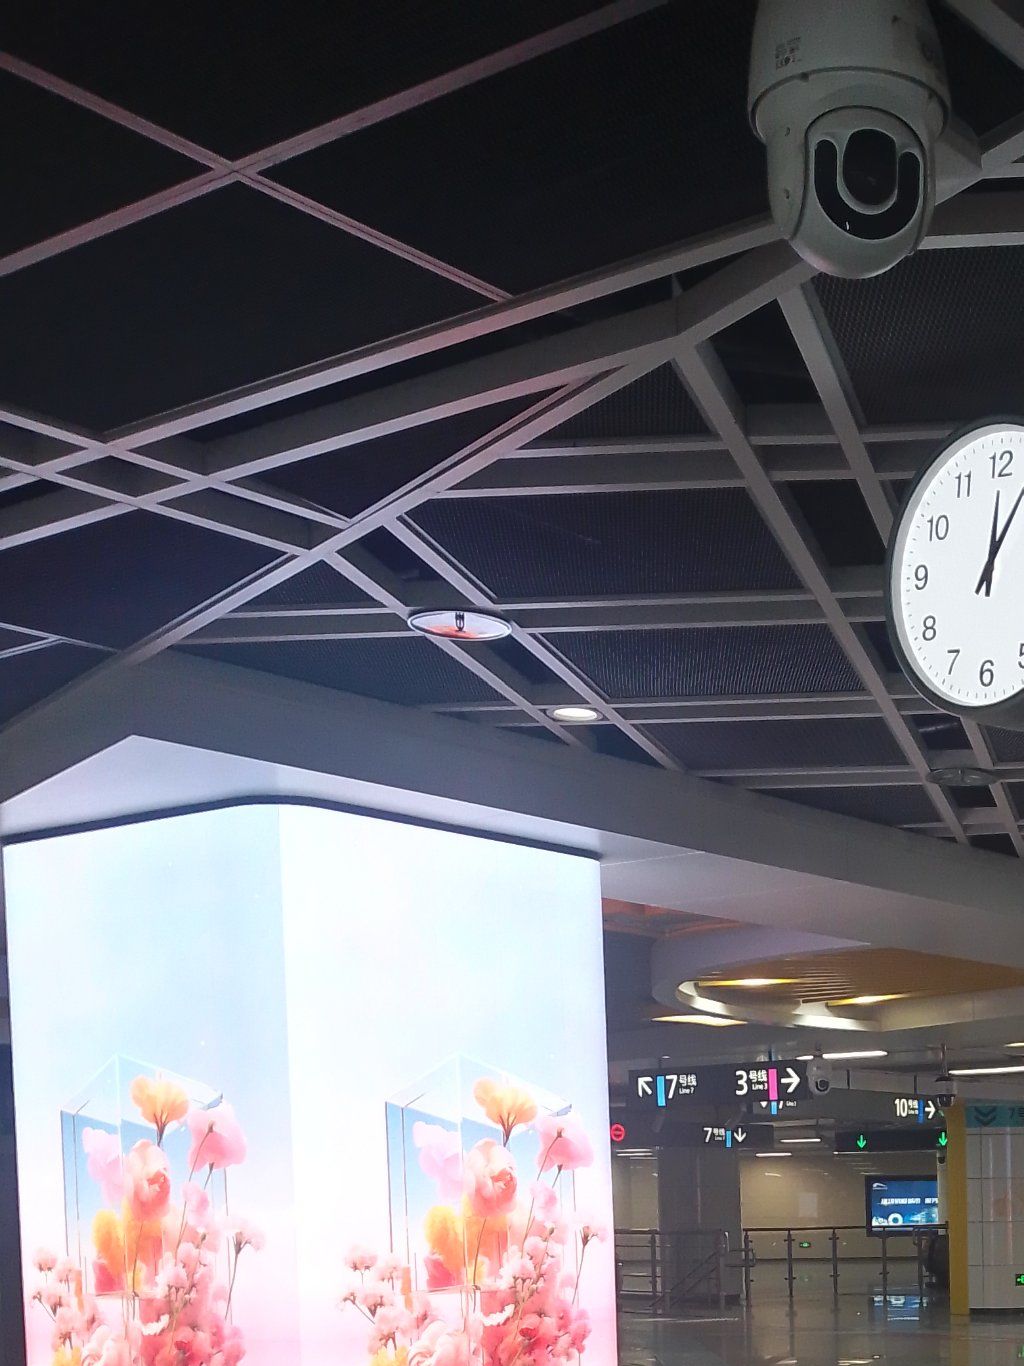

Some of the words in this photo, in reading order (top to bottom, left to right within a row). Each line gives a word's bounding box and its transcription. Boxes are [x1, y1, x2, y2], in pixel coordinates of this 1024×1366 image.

[988, 450, 1014, 478] 12
[955, 470, 973, 499] 11
[927, 514, 949, 542] 10
[914, 564, 929, 590] 9
[922, 615, 937, 641] 8
[947, 649, 961, 675] 7
[979, 659, 995, 687] 6
